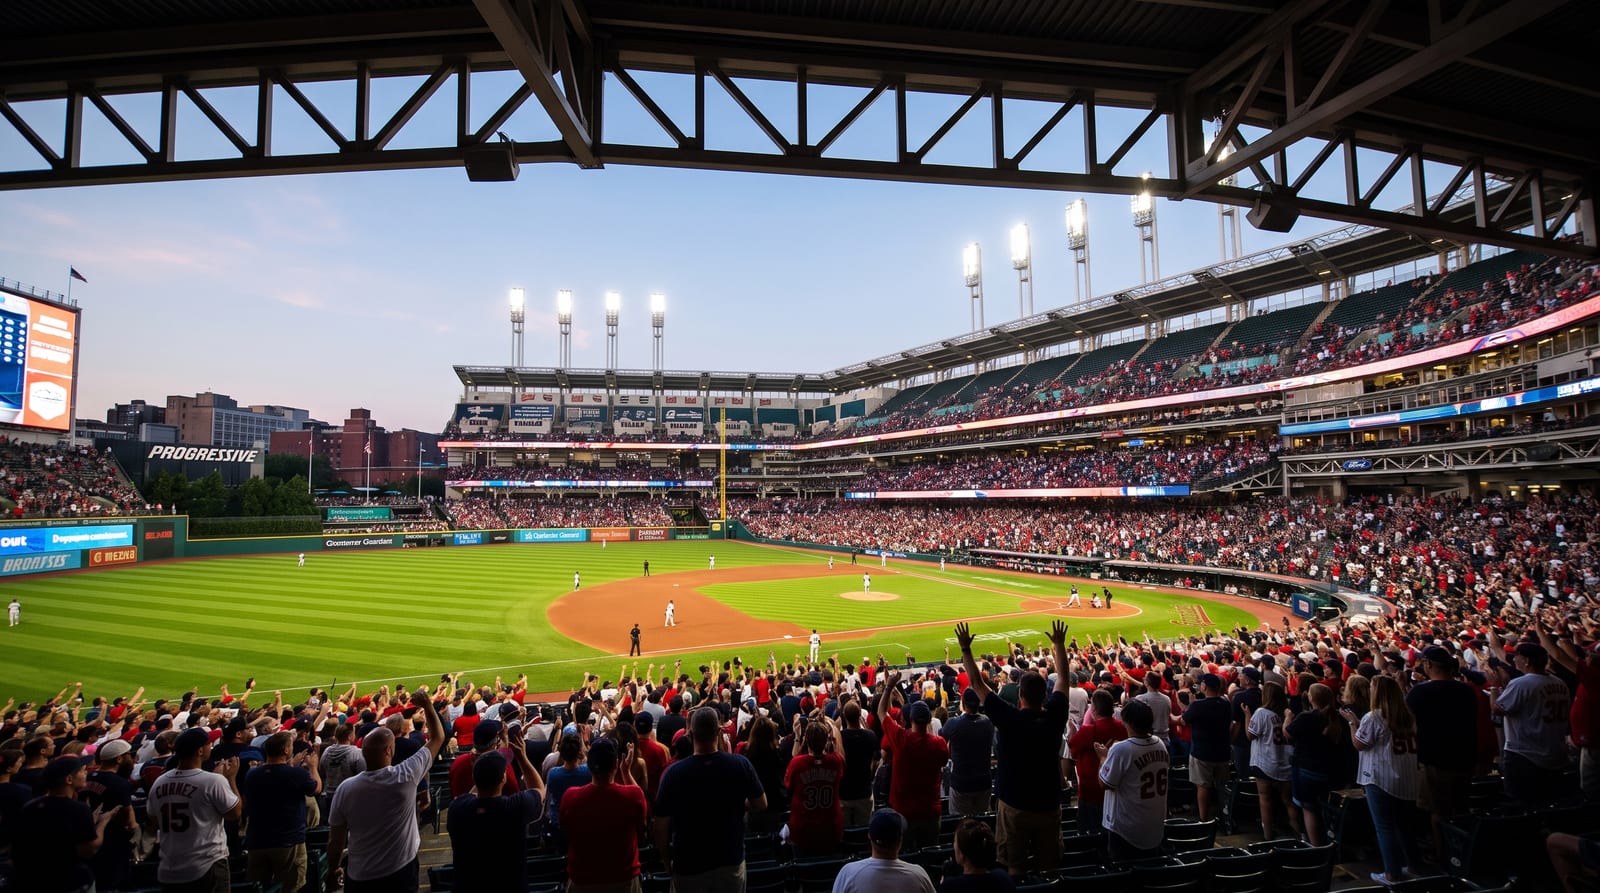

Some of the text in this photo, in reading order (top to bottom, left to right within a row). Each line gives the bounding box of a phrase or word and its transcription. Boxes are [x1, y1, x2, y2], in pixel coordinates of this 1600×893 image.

[148, 445, 258, 463] PROGRESSIVE
[802, 785, 834, 810] 30
[1141, 768, 1167, 800] 26
[161, 803, 190, 833] 15
